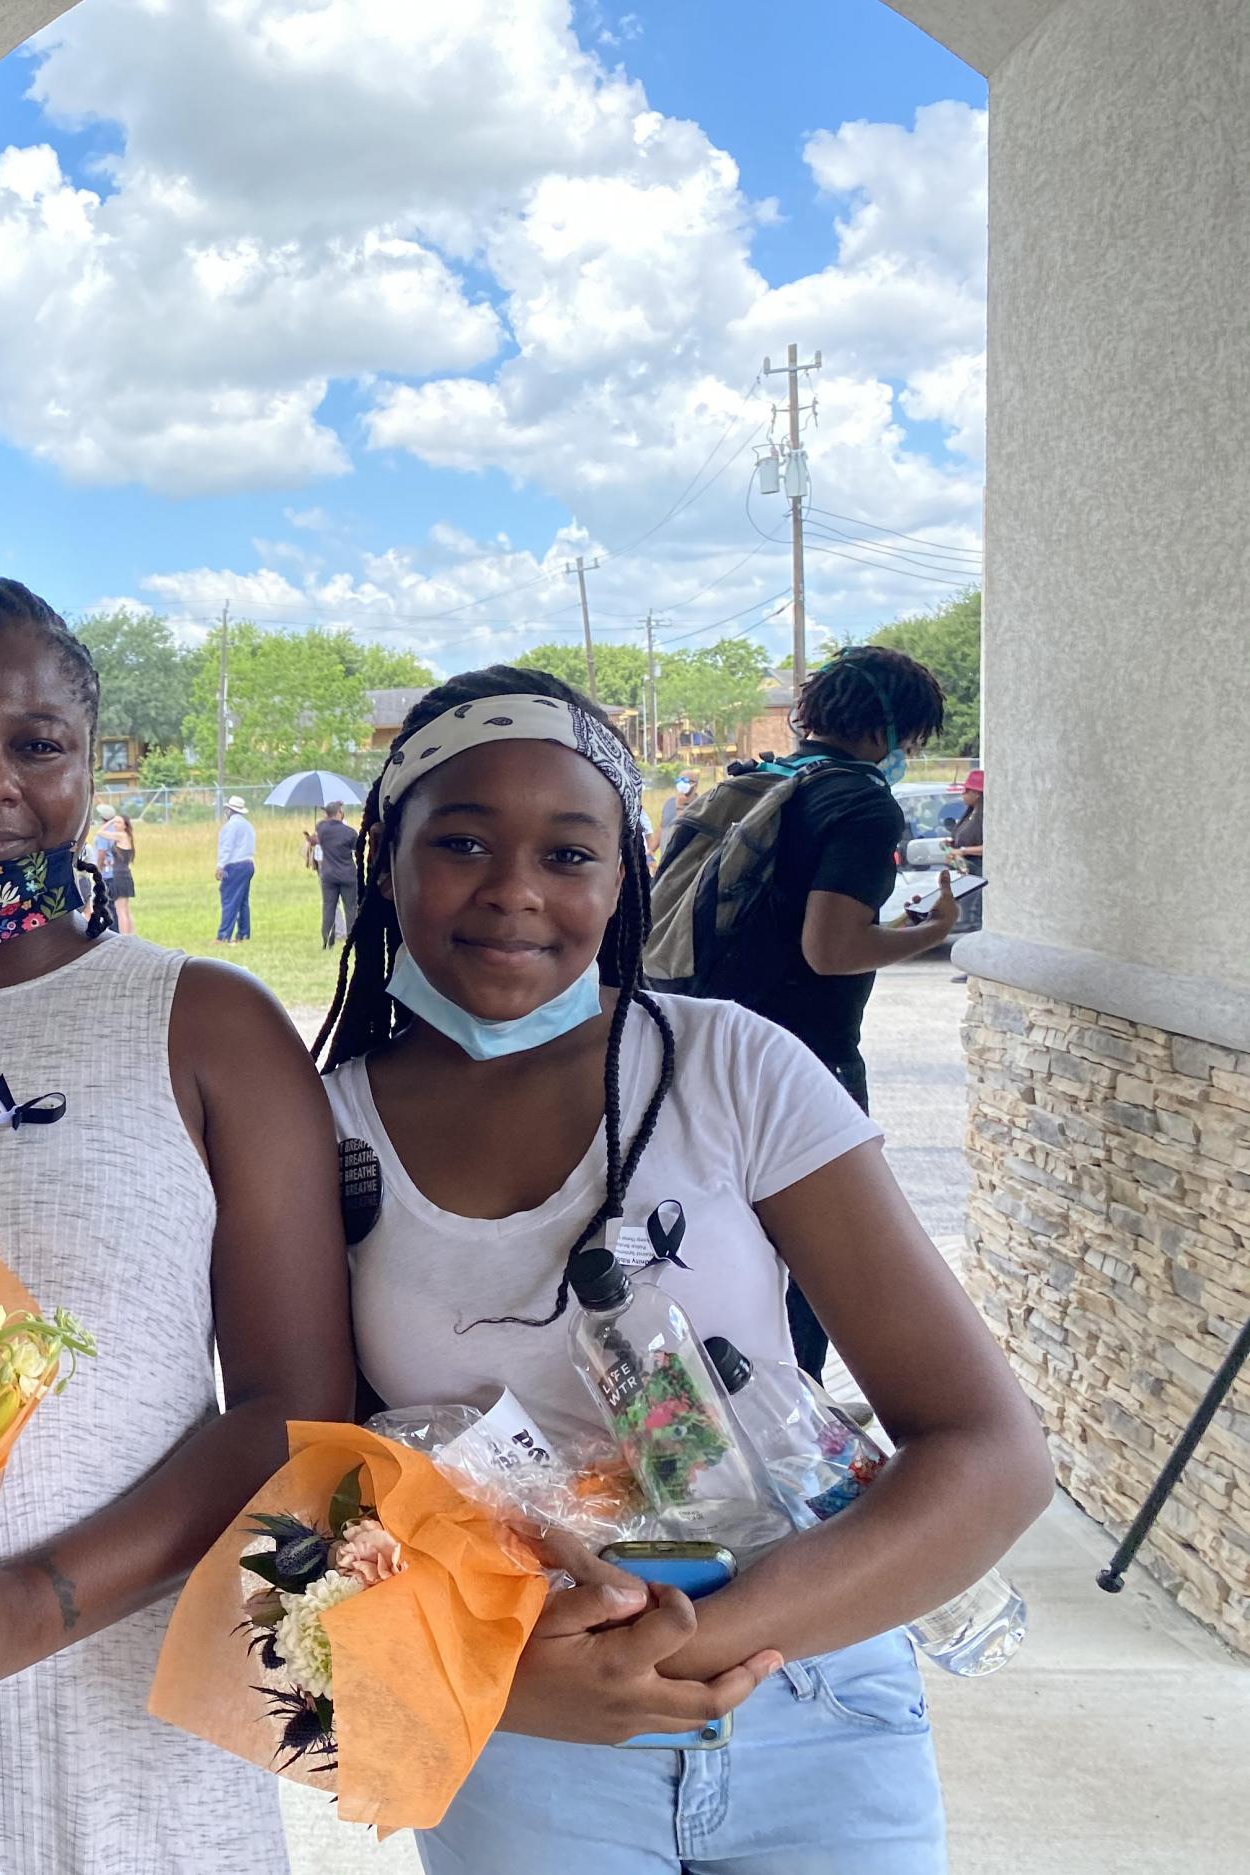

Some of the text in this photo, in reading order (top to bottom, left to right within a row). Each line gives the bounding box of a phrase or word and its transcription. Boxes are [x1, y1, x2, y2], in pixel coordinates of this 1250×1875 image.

[344, 1164, 377, 1182] BREATHE
[602, 1362, 631, 1395] LIFE
[609, 1376, 638, 1407] WTR
